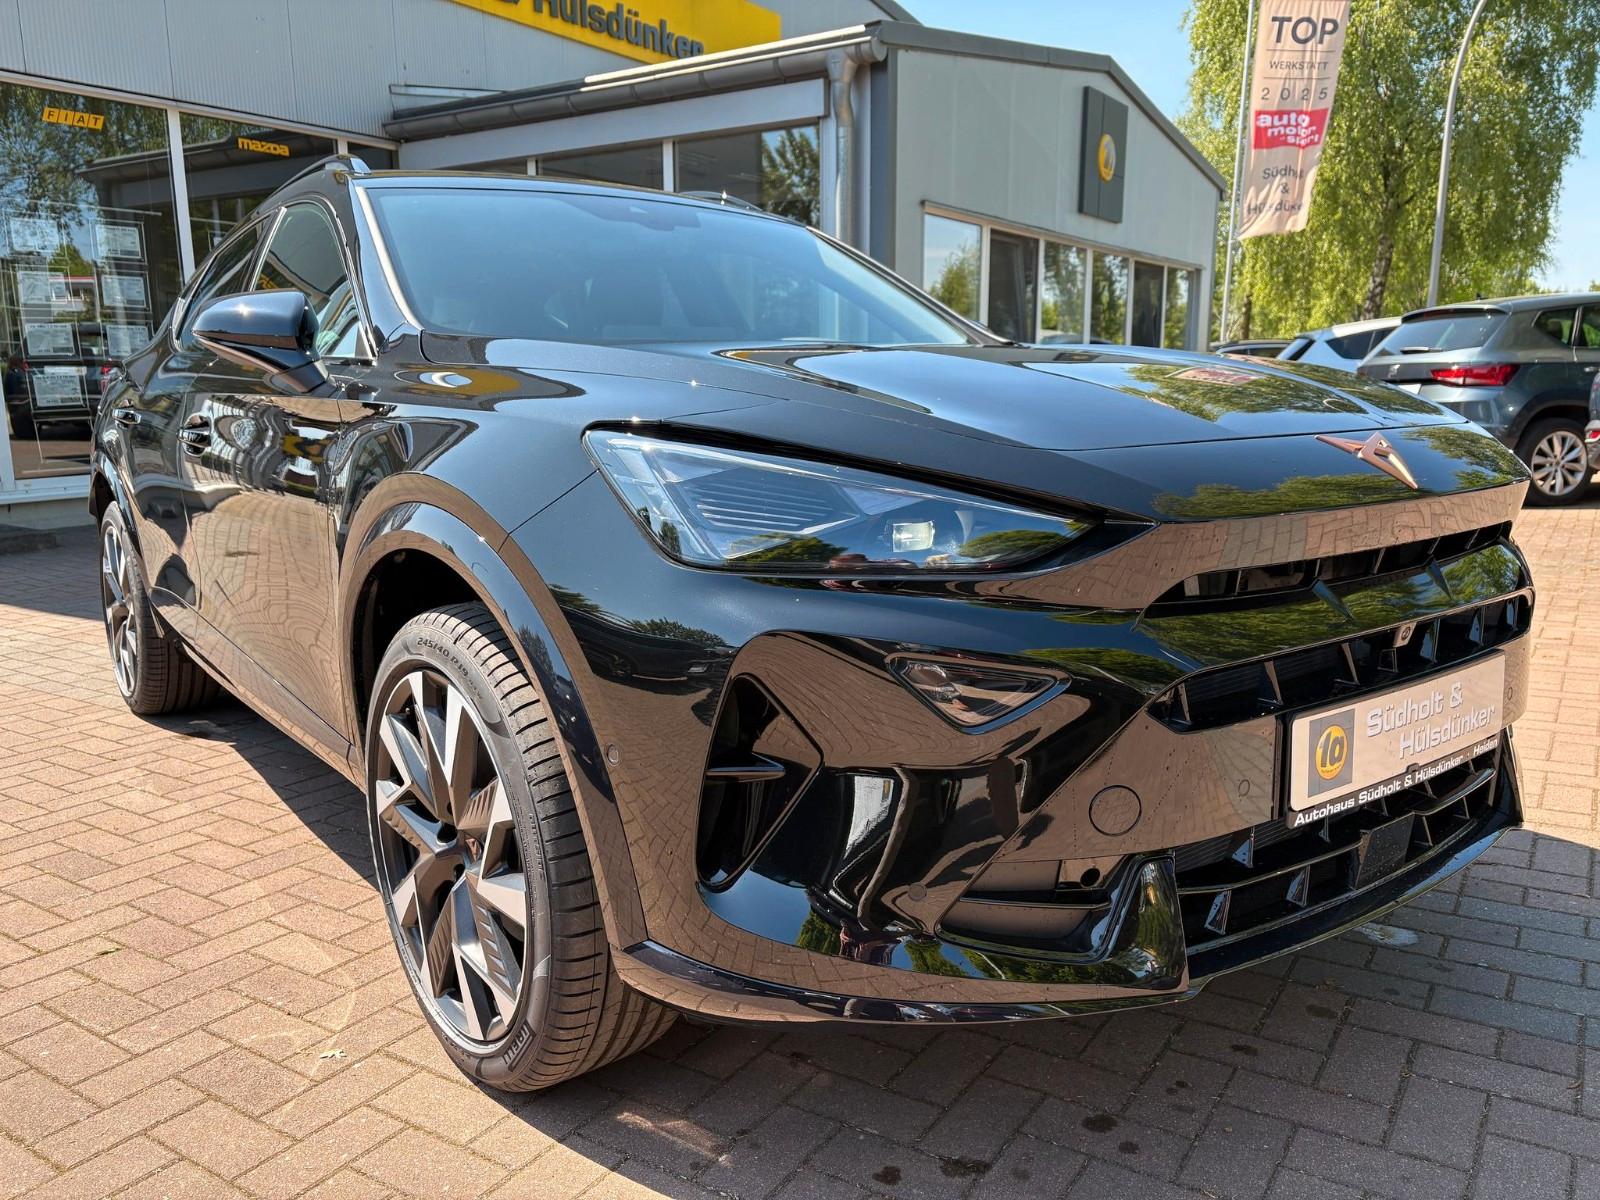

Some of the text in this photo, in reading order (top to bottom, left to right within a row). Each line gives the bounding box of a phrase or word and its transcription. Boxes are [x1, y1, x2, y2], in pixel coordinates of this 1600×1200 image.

[1271, 16, 1339, 45] TOP
[1269, 61, 1329, 71] WERKSTATT
[46, 109, 101, 128] FIAT
[1256, 112, 1310, 127] auto
[238, 137, 290, 157] mazda
[1366, 681, 1464, 738] Südholt &
[1399, 704, 1496, 760] Hülsdünker
[1294, 738, 1498, 828] Autohaus Südholt & Hülsdünker Heiden
